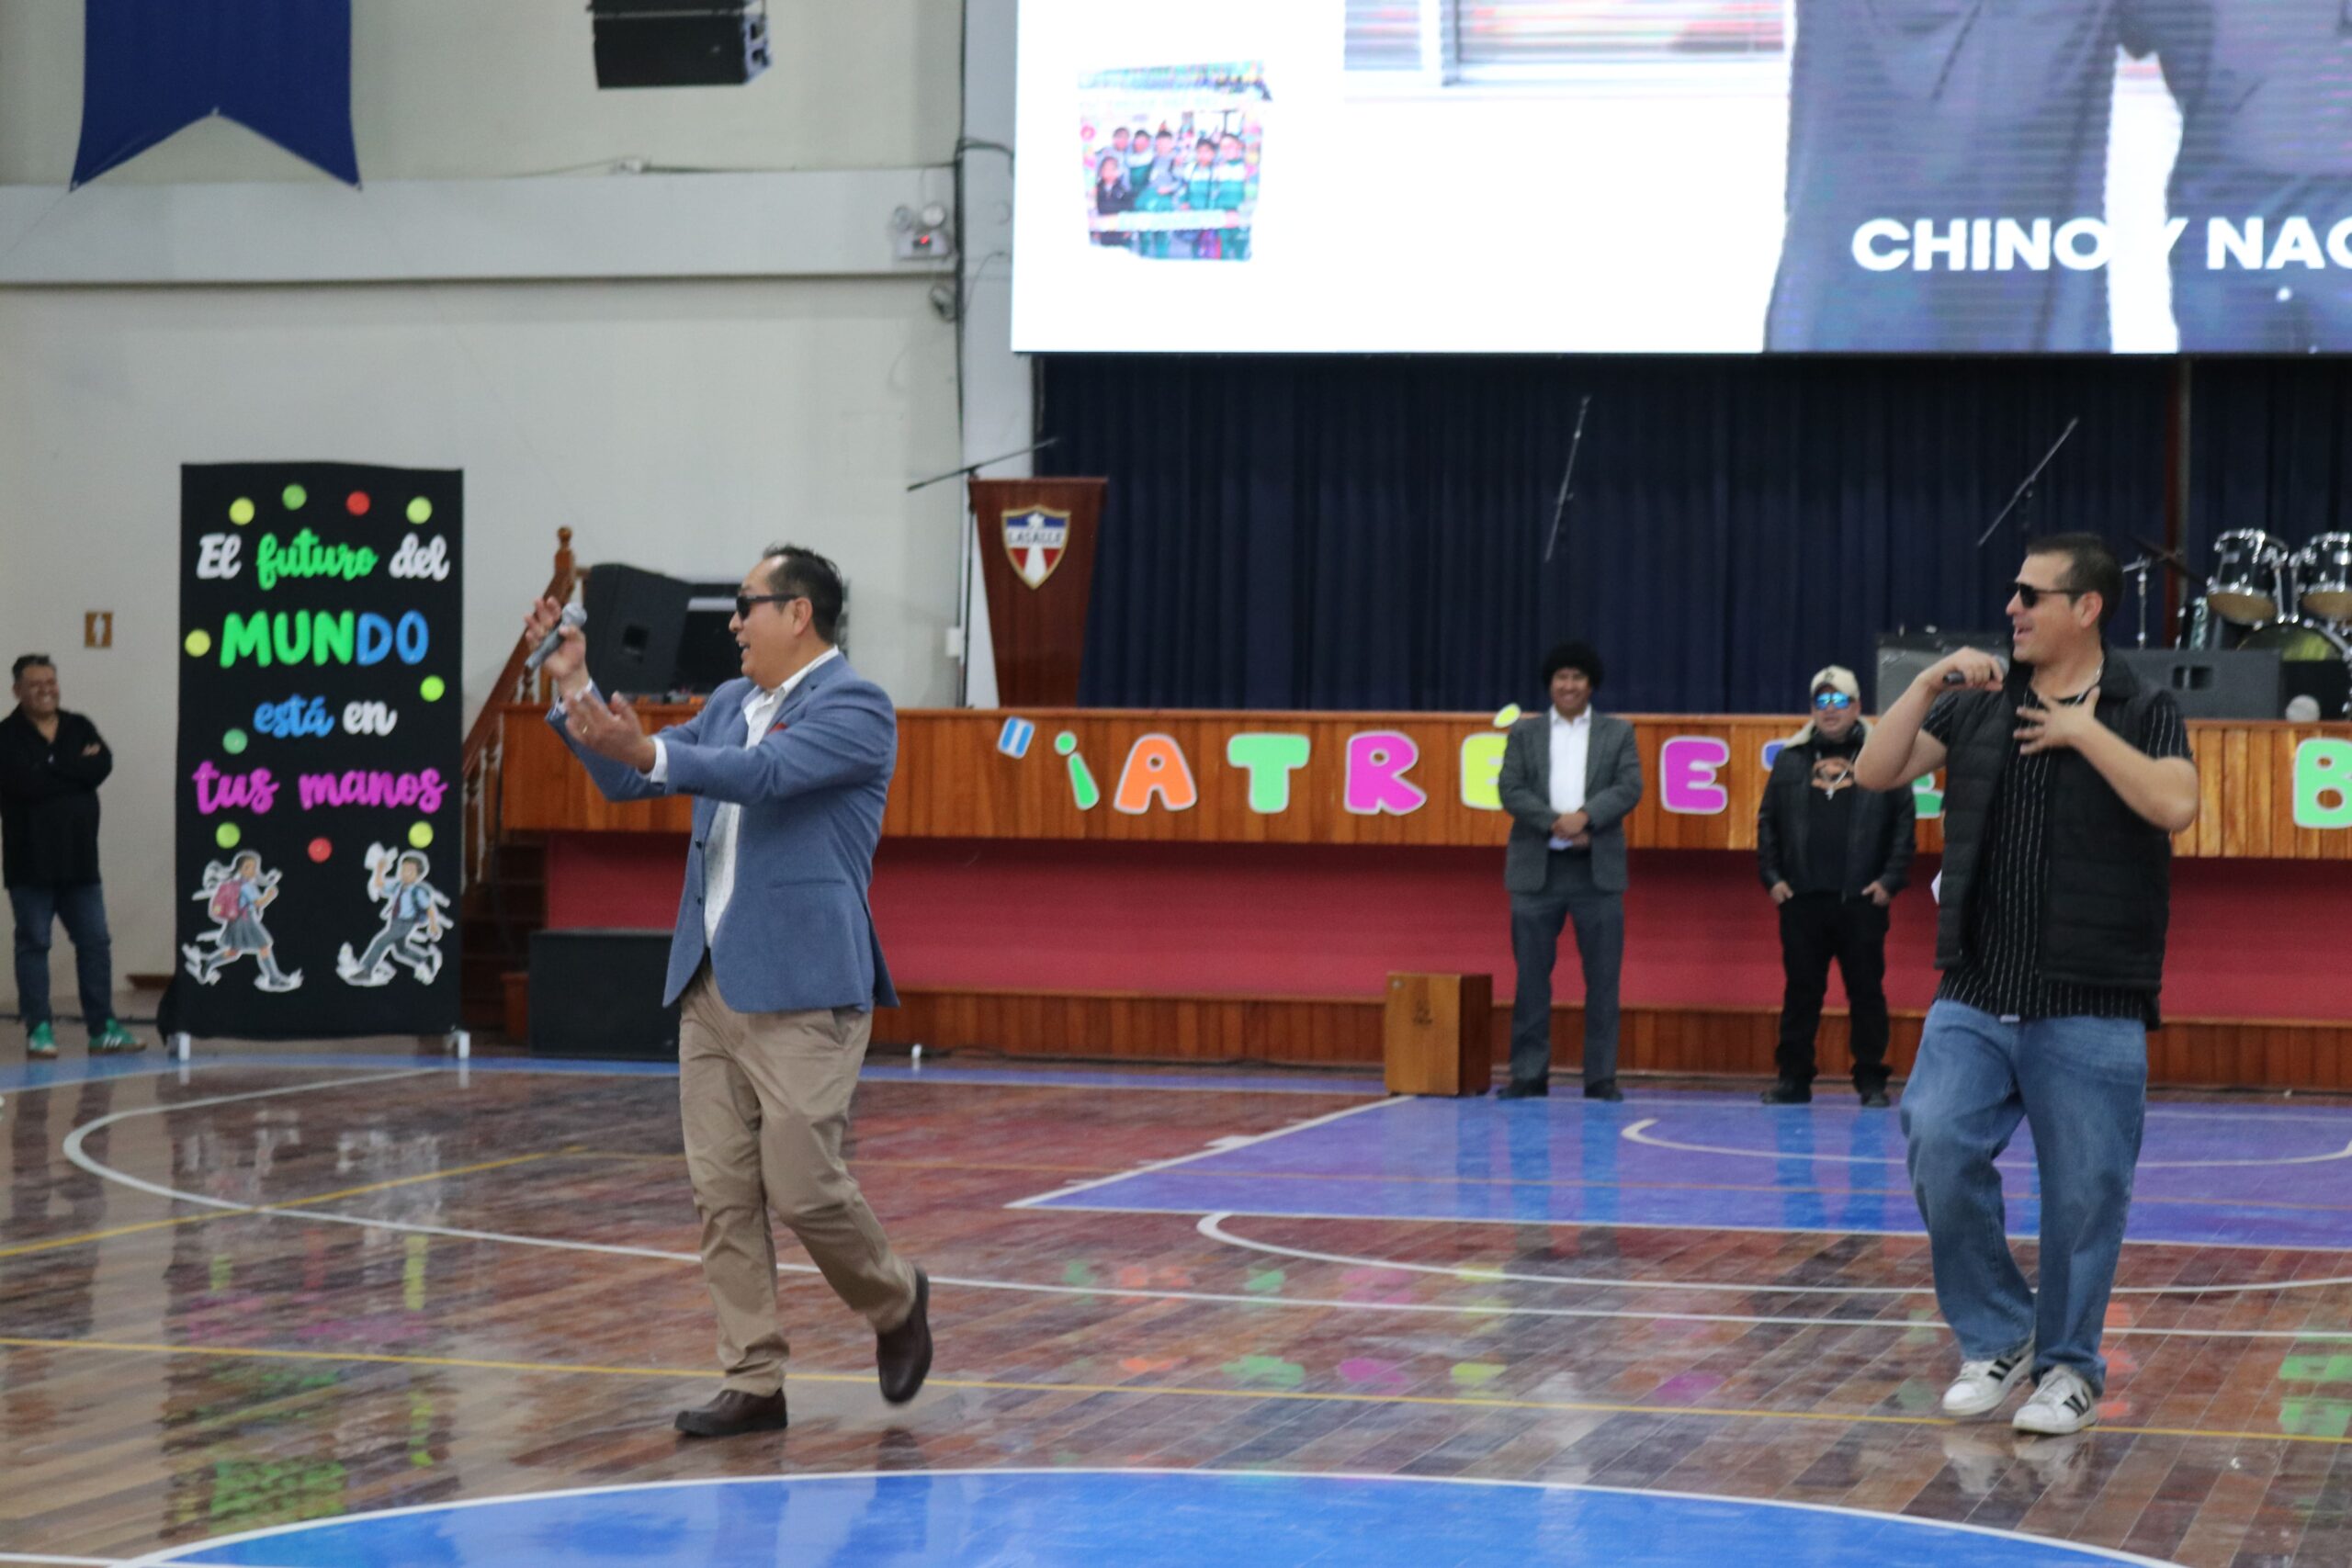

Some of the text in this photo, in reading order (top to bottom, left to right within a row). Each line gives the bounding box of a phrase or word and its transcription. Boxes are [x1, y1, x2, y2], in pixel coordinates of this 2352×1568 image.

[1851, 218, 2111, 271] CHINO
[197, 527, 450, 591] El futuro del
[220, 610, 429, 668] MUNDO
[253, 694, 398, 739] está en
[192, 760, 448, 815] tus manos
